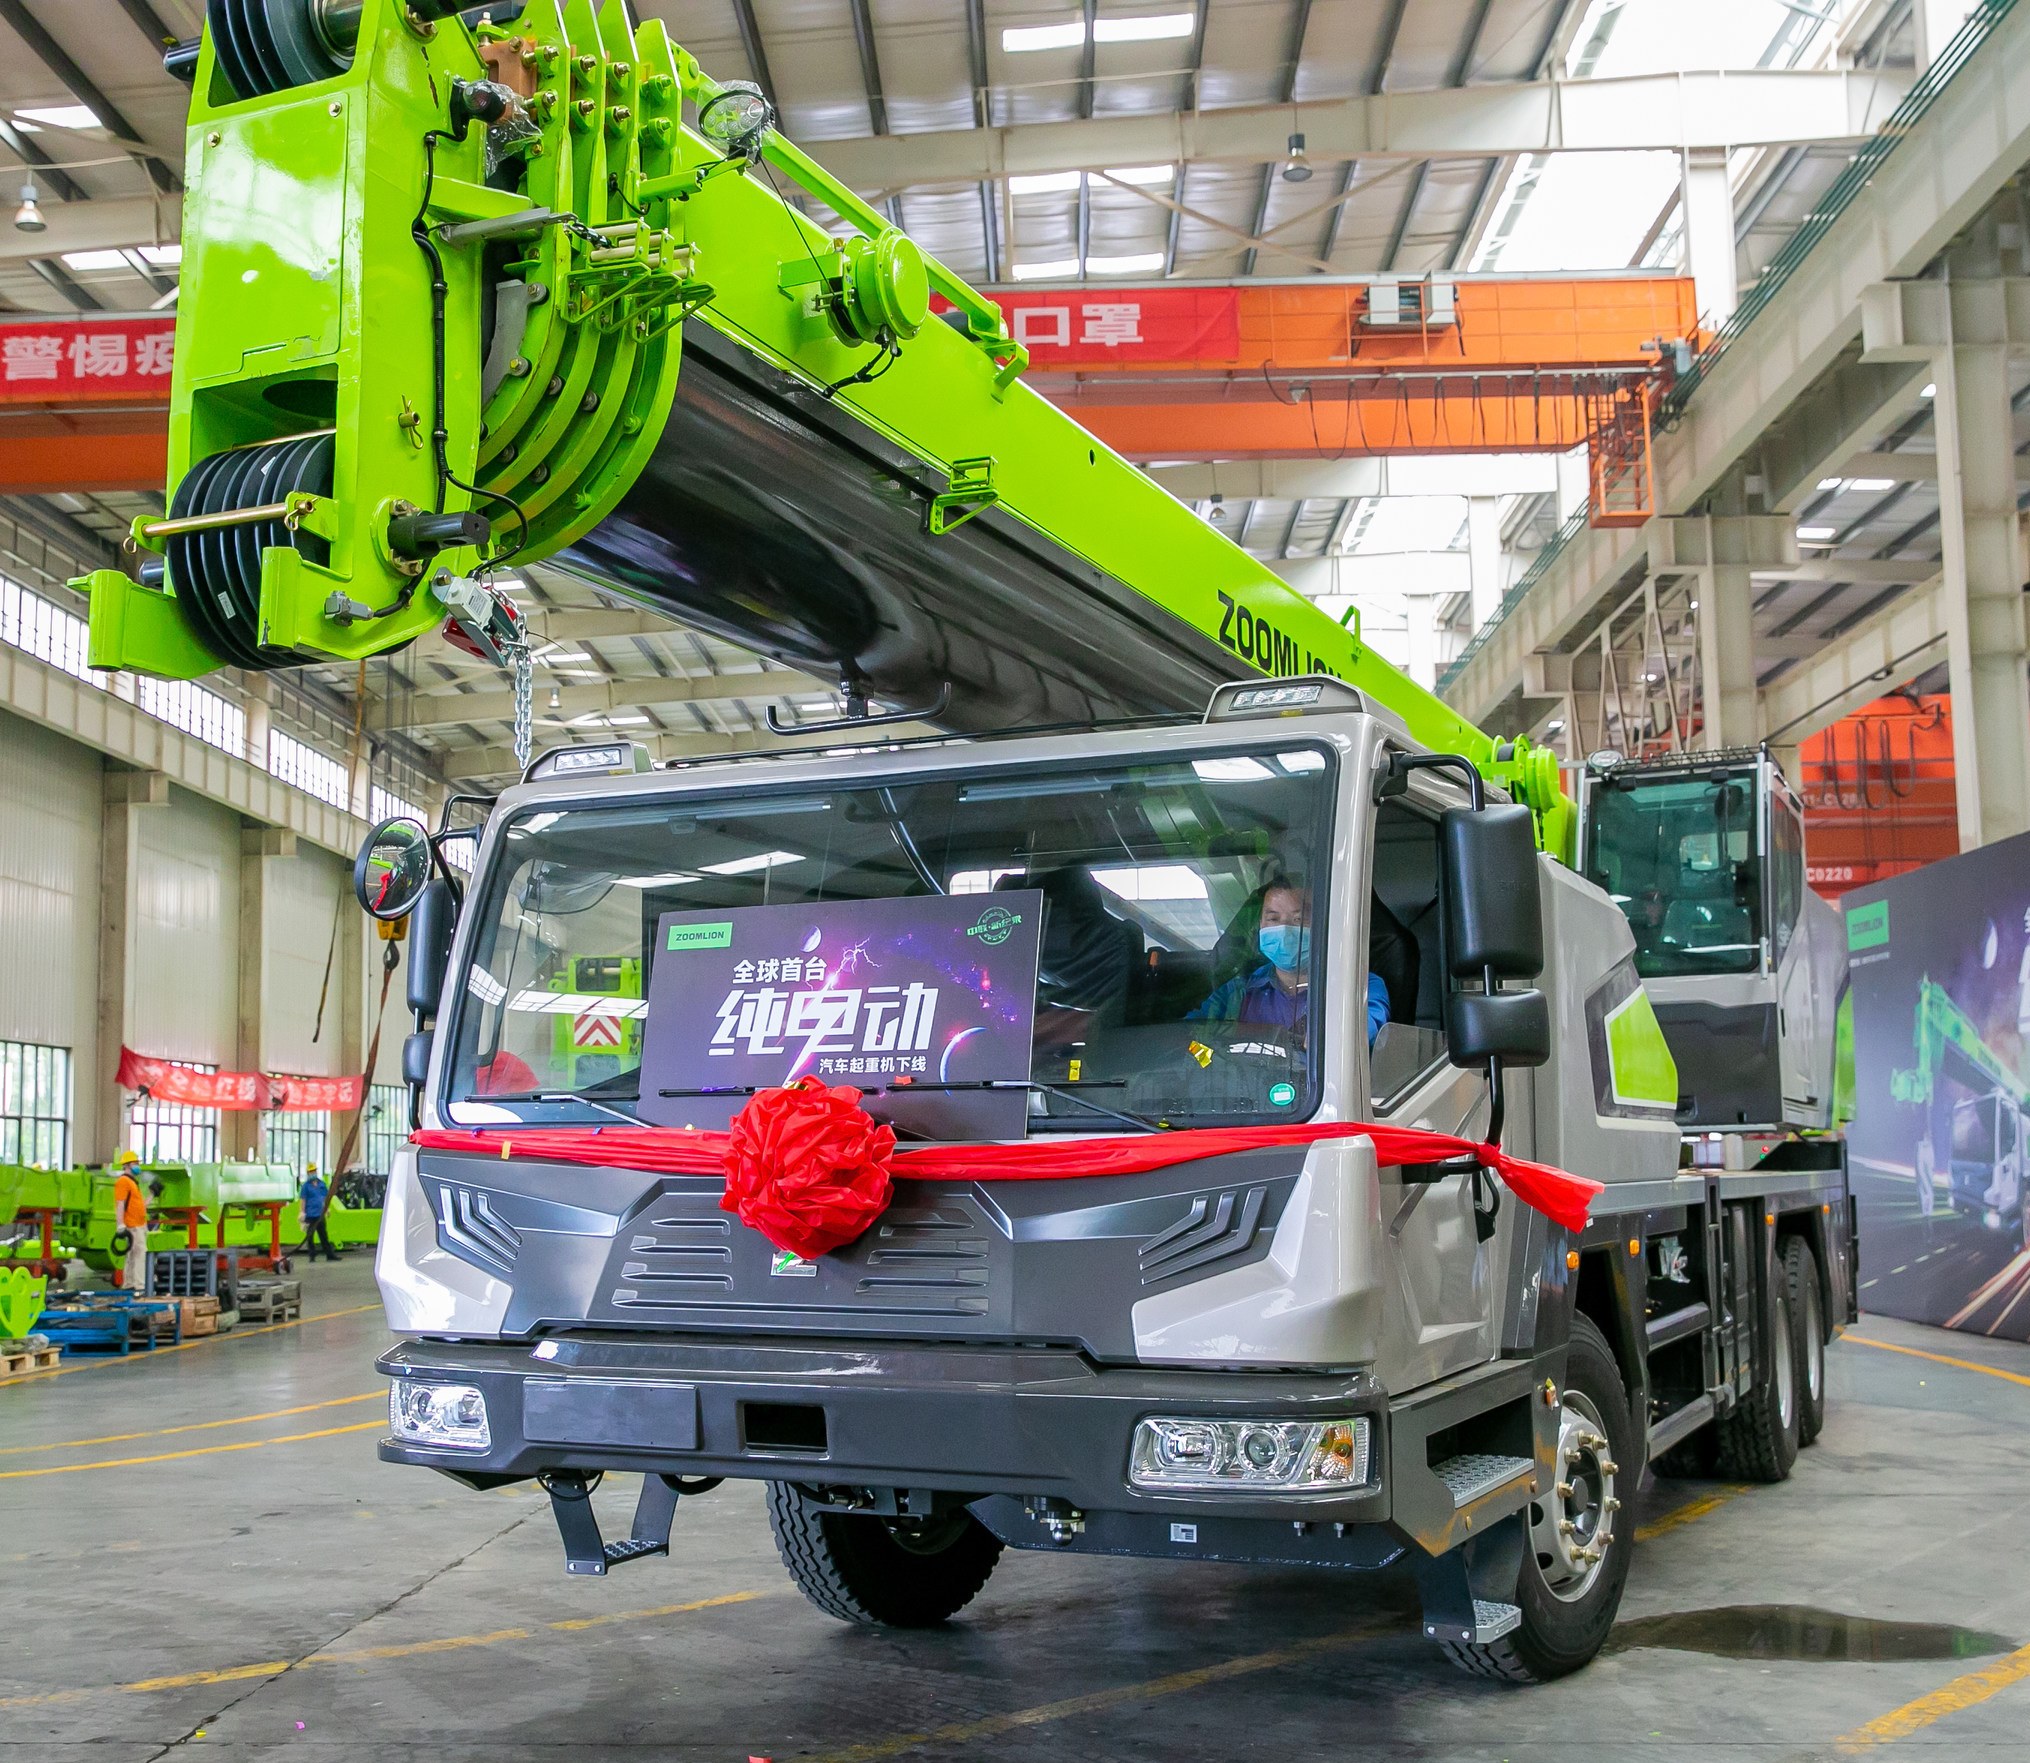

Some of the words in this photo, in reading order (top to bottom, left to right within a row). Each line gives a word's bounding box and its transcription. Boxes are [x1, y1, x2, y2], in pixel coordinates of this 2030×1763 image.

[1013, 303, 1144, 347] 口罩
[1217, 589, 1342, 679] ZOOML
[675, 931, 725, 942] ZOOMLION
[732, 955, 828, 984] 全球首台
[708, 982, 939, 1058] 纯电动
[818, 1055, 927, 1074] 汽车起重机下线
